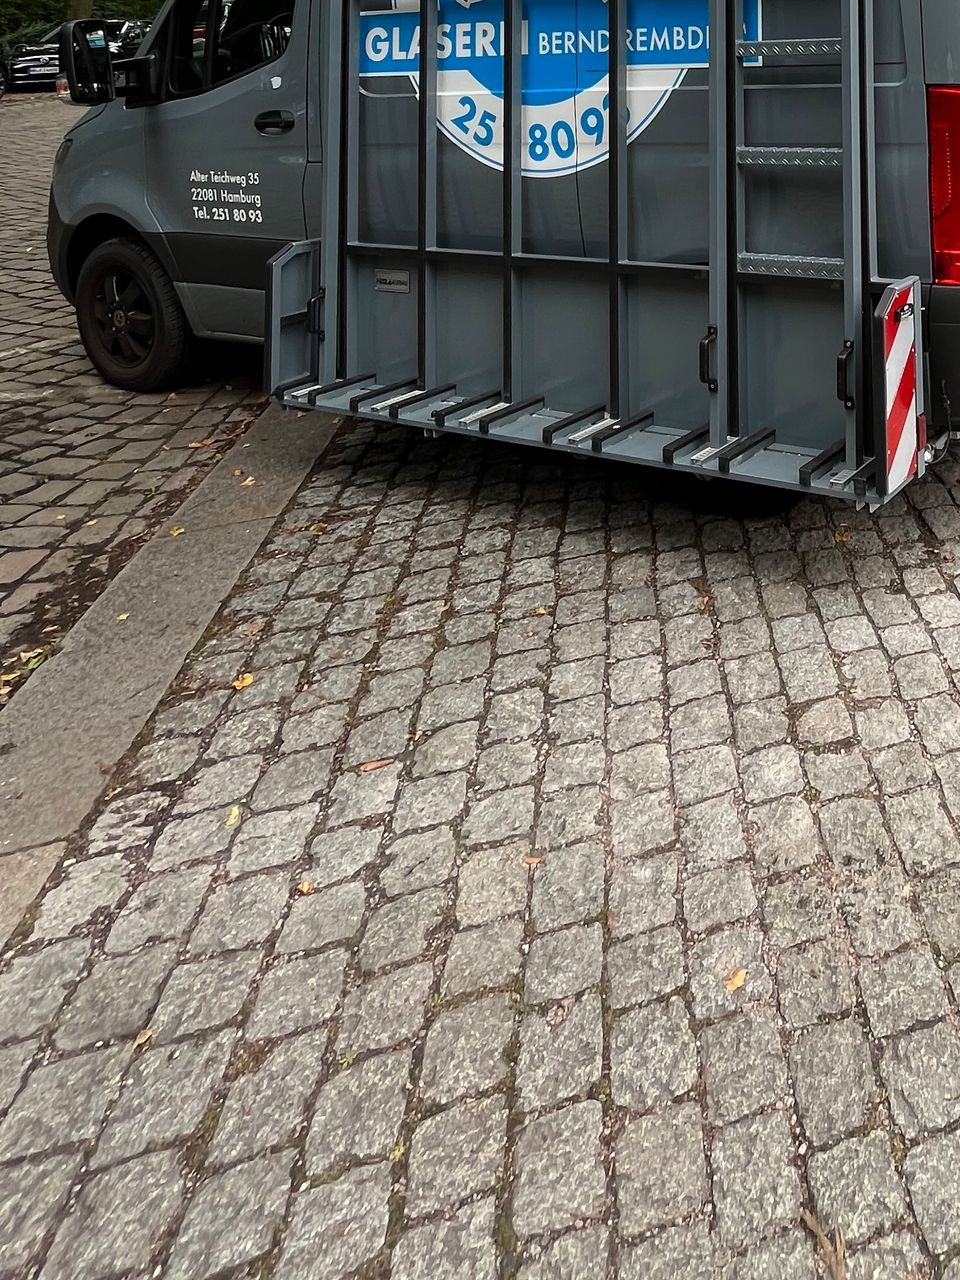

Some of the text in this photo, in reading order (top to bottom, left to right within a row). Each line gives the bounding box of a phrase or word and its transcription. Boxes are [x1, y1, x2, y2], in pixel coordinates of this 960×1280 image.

[539, 30, 610, 55] BERND
[528, 120, 575, 162] 80
[190, 170, 259, 187] Alter Teichweg 35
[191, 188, 261, 207] 22081 Hamburg
[193, 206, 262, 223] Tel. 251 80 93
